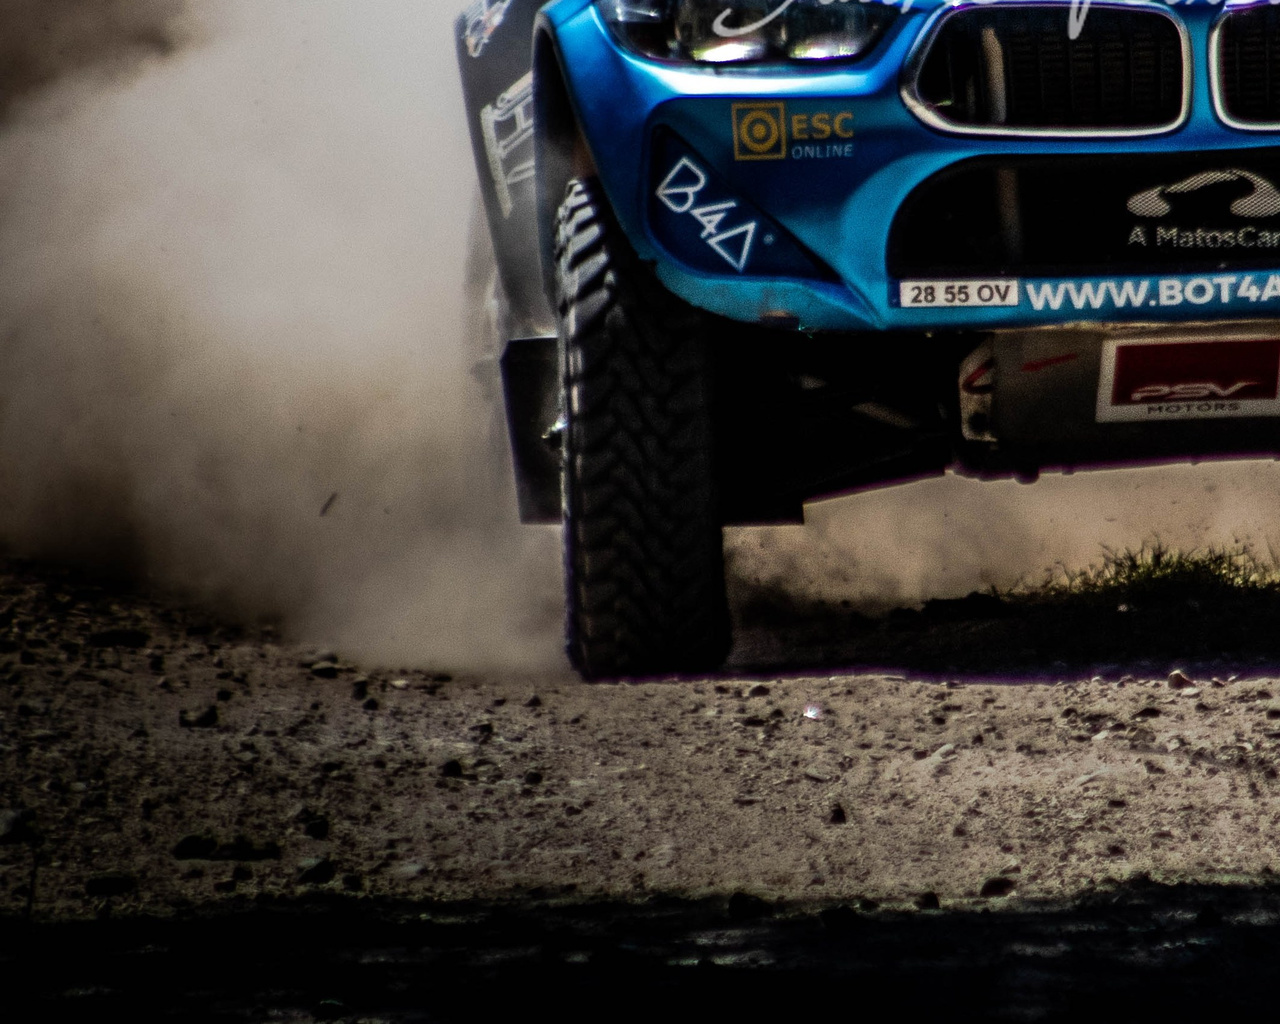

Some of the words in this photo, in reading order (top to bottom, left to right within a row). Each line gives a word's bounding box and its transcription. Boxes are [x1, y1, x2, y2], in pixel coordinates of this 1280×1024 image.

[791, 112, 854, 140] ESC
[791, 144, 854, 160] ONLINE
[1128, 227, 1147, 246] A
[911, 285, 936, 304] 28
[944, 285, 970, 304] 55
[976, 284, 1011, 303] OV
[1147, 402, 1241, 415] MOTORS
